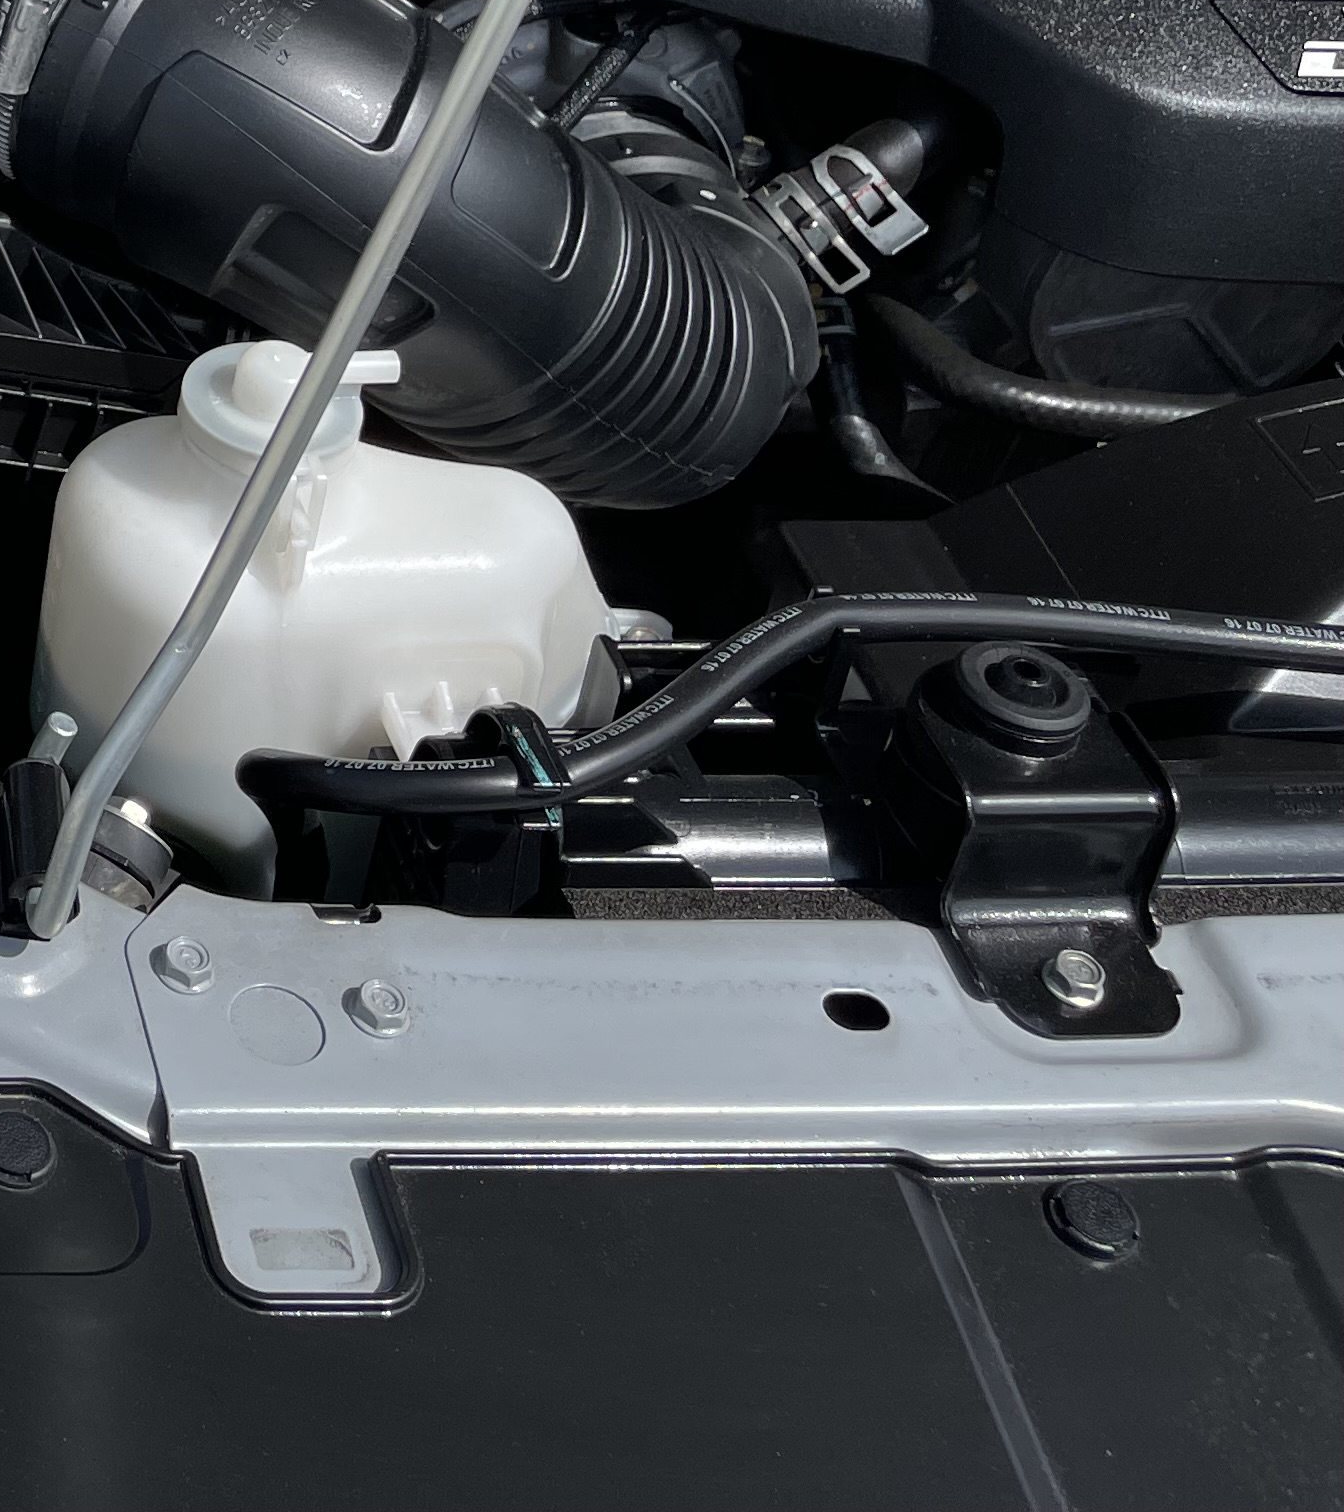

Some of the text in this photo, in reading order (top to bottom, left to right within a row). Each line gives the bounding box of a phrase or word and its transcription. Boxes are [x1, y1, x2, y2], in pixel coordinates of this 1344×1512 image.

[1049, 598, 1065, 608] 07
[1067, 600, 1083, 610] 07
[1082, 601, 1138, 616] WATER
[1138, 608, 1171, 620] ITTC
[1224, 618, 1242, 629] 16
[1246, 620, 1263, 632] 07
[1265, 622, 1282, 634] 07
[1282, 624, 1339, 641] WATER
[700, 606, 803, 672] ITTC WATER 07 07 16
[645, 694, 674, 713] ITTC
[607, 711, 652, 737] WATER
[344, 761, 361, 769] 07
[368, 761, 385, 770] 07
[391, 761, 454, 771] WATER
[458, 759, 495, 769] ITTC
